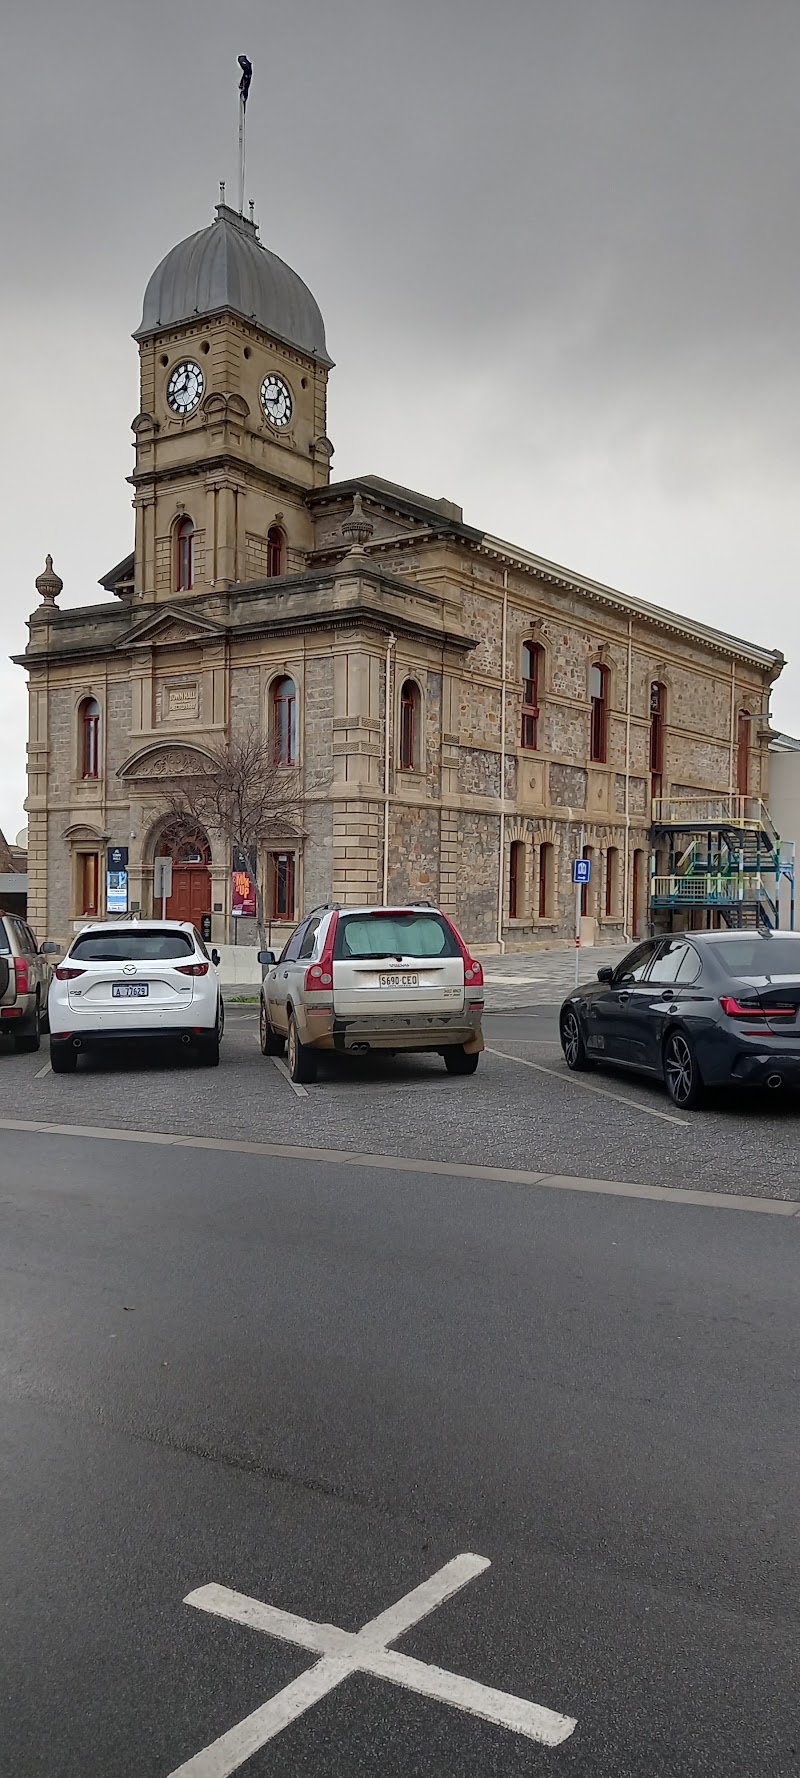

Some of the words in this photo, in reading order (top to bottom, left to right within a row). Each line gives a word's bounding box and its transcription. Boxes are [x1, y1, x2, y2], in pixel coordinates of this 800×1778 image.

[169, 692, 183, 701] TOWN
[183, 691, 196, 699] HALL
[239, 885, 250, 899] UP
